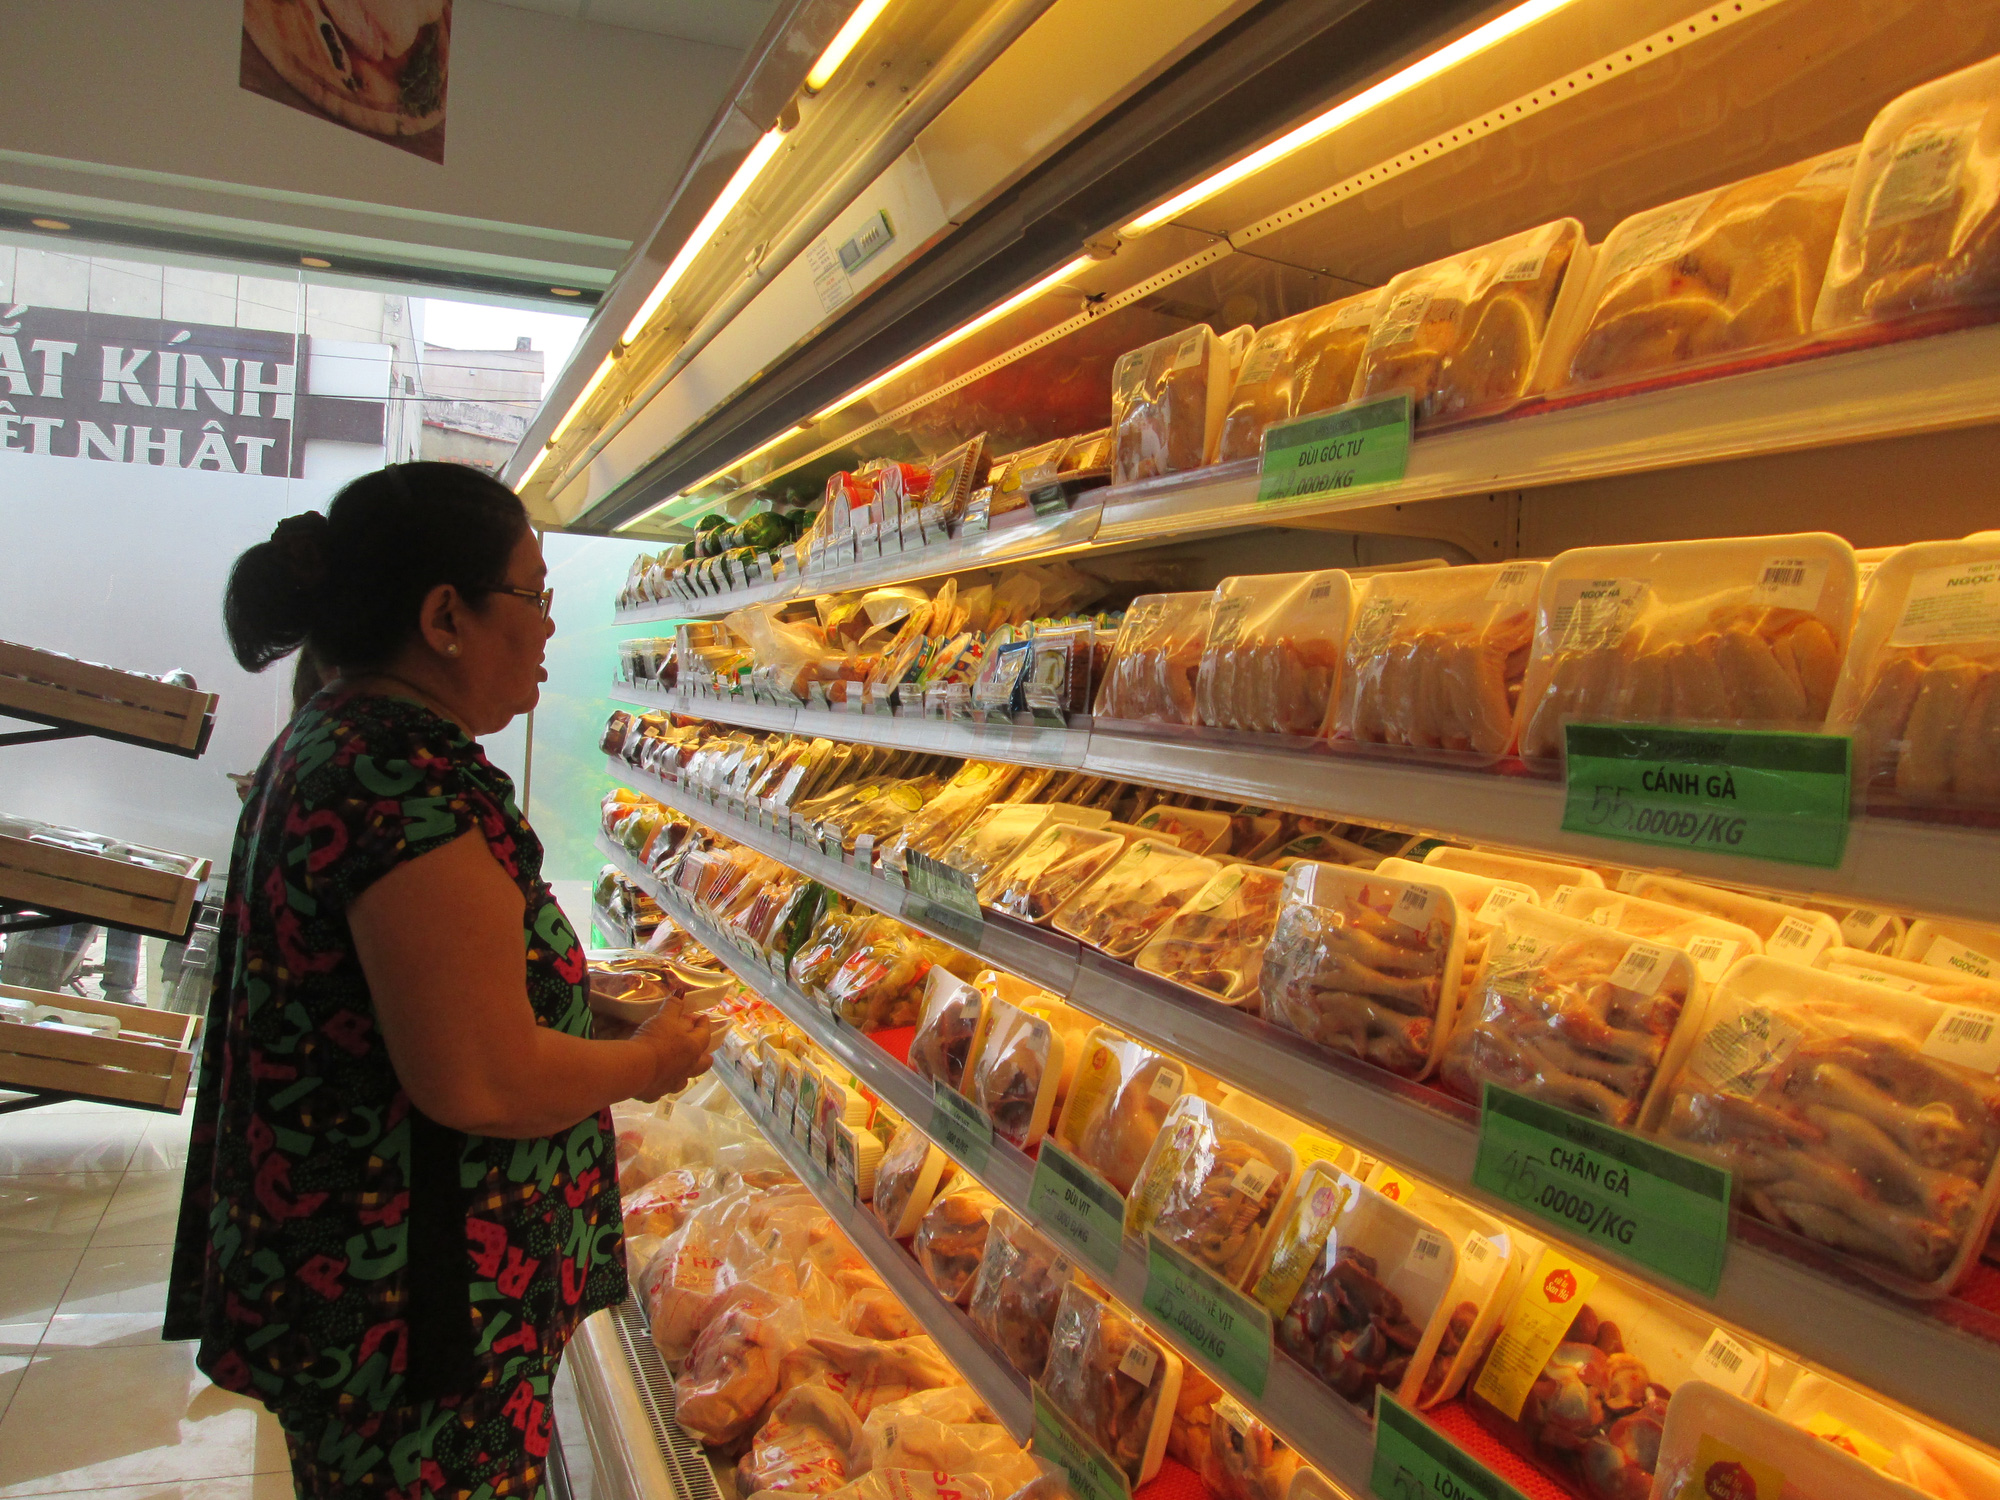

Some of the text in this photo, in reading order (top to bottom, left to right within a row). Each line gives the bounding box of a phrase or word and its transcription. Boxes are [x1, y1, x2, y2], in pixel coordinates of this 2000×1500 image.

[99, 330, 294, 420] KÍNH
[1320, 440, 1345, 463] GÓC
[1642, 766, 1736, 800] CÁNH GÀ
[1550, 1147, 1630, 1198] CHÂN GÀ
